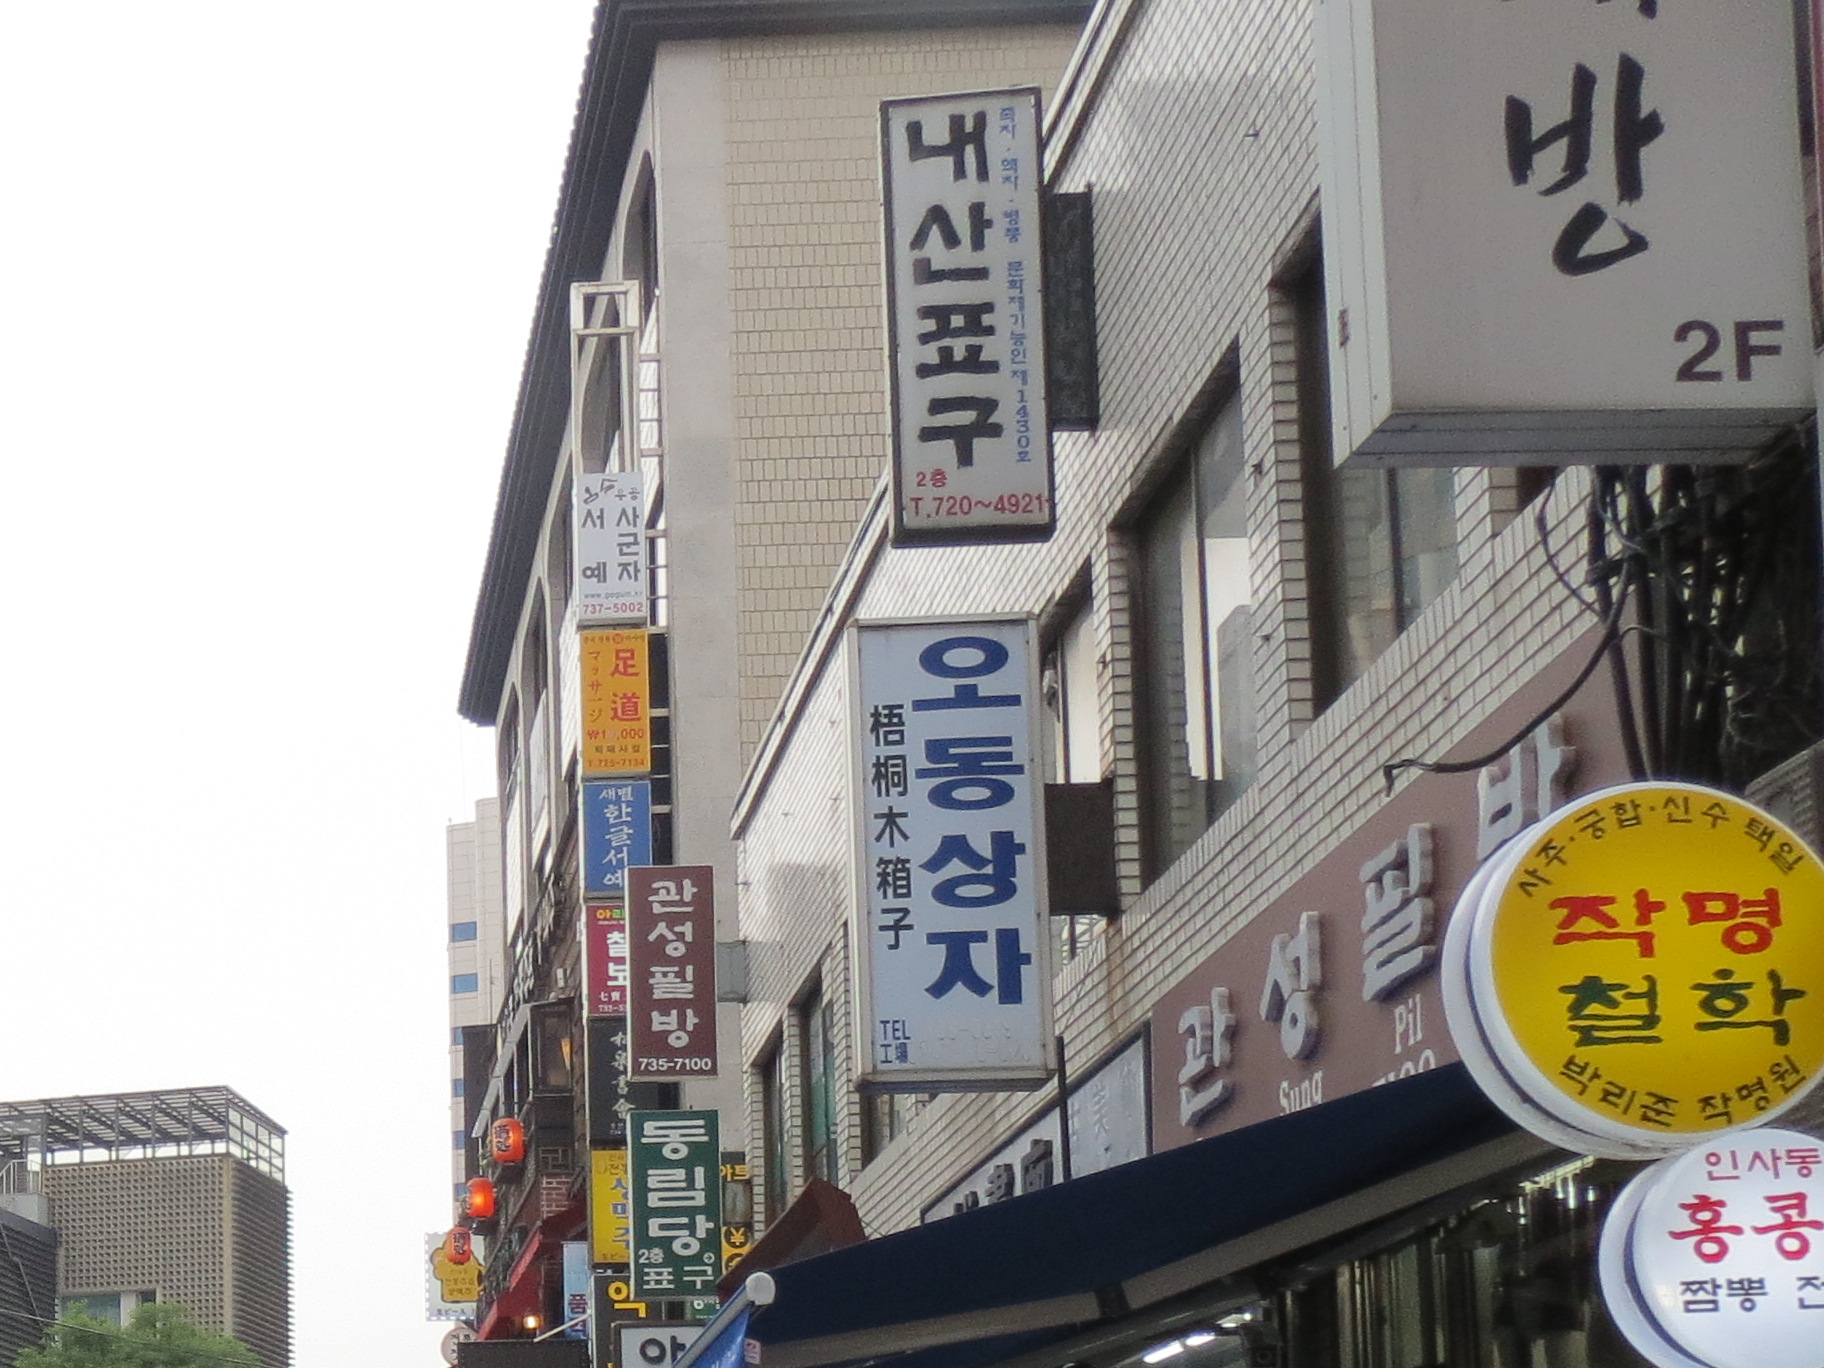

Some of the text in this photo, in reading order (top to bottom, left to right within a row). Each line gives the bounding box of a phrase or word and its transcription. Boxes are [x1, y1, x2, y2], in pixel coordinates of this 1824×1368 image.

[1503, 0, 1665, 277] 방
[906, 111, 1004, 467] 내산표구
[1673, 319, 1784, 382] 2F
[916, 468, 947, 487] 2층
[583, 602, 643, 614] 737-5002
[610, 648, 641, 722] 足道
[599, 786, 634, 801] 새별
[870, 704, 914, 950] 梧桐木箱子
[912, 636, 1031, 1004] 오동상자
[1178, 713, 1575, 1126] 관성필방
[1549, 888, 1783, 958] 작명
[648, 878, 700, 1048] 관성필방
[879, 1020, 911, 1040] TEL
[1394, 994, 1423, 1054] Pil
[1557, 969, 1807, 1048] 철학
[638, 1057, 712, 1071] 735-7100
[1559, 1054, 1807, 1127] 박리준 작명원
[640, 1119, 715, 1256] 동림당
[1704, 1148, 1823, 1181] 인사동
[638, 1248, 664, 1264] 2층
[1667, 1191, 1824, 1264] 홍콩
[1679, 1276, 1769, 1314] 짬뽕
